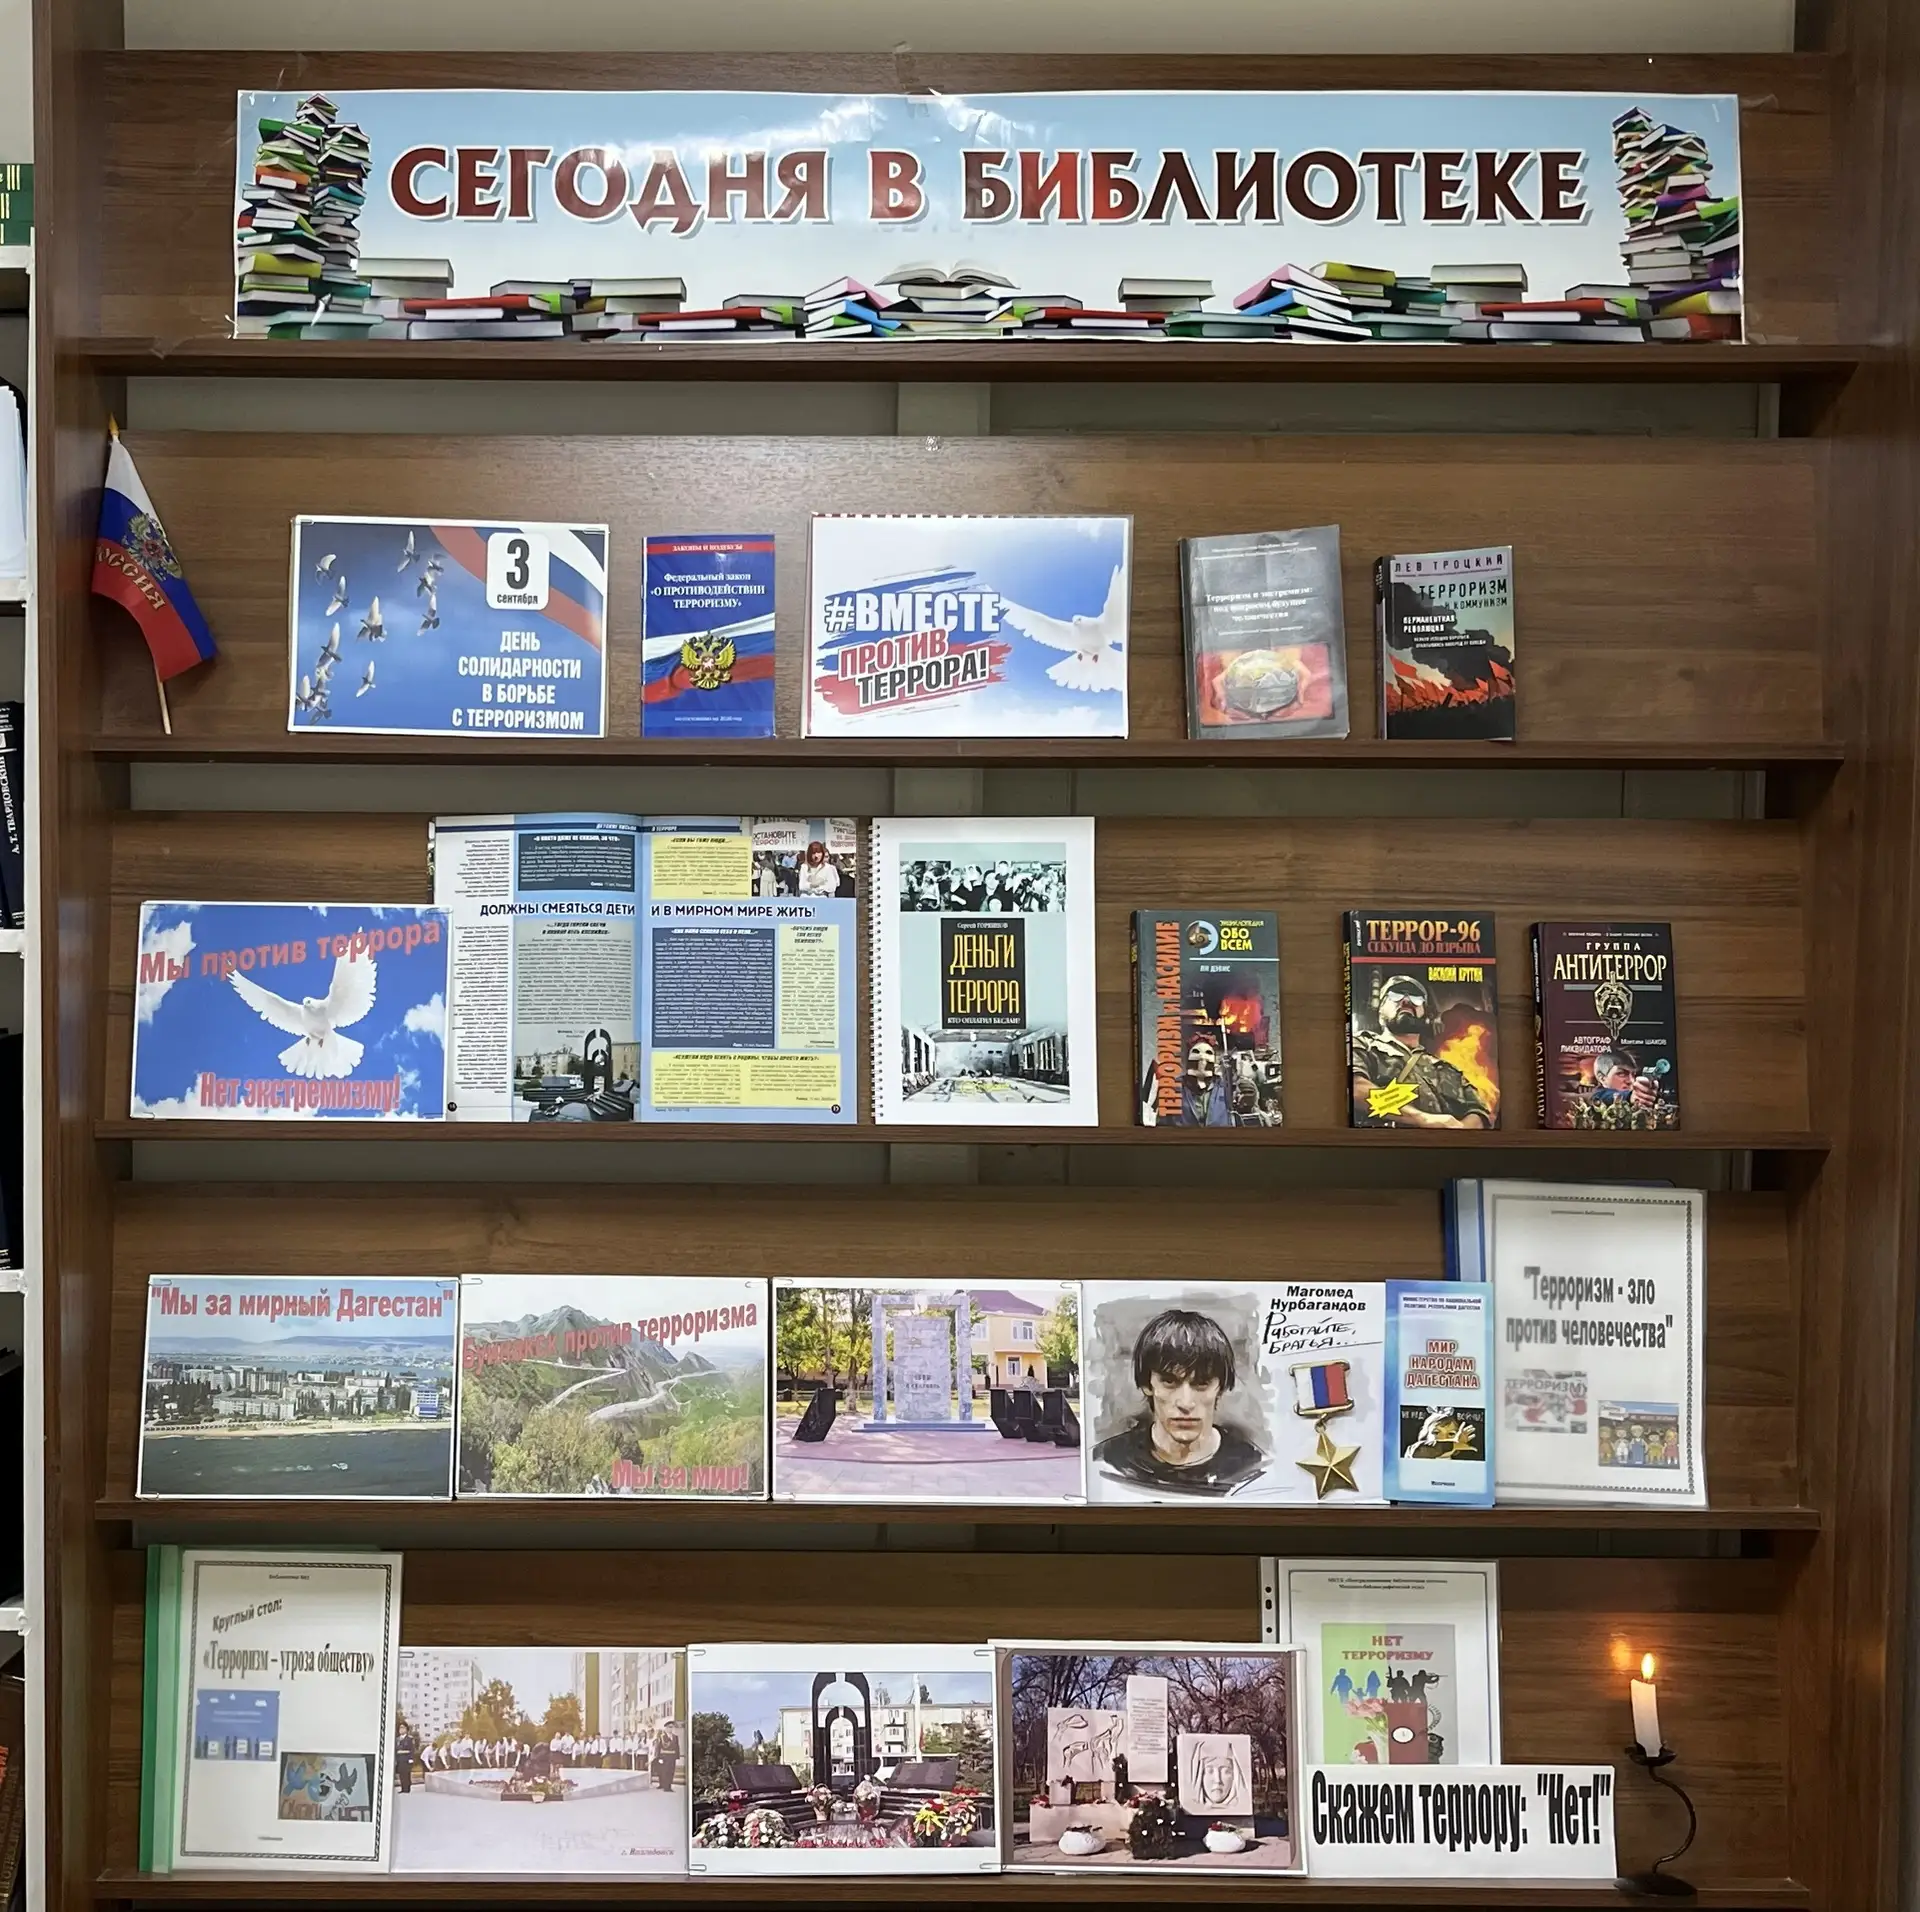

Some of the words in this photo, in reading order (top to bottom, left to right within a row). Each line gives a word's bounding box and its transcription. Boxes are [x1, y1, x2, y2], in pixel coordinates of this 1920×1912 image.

[389, 145, 830, 237] СЕГОДНЯ
[867, 147, 925, 222] В
[959, 148, 1589, 225] БИБЛИОТЕКЕ
[506, 538, 530, 590] 3
[1394, 562, 1422, 573] ЛЕВ
[1433, 554, 1504, 570] ТРОЦКИЙ
[664, 573, 724, 583] Федеральный
[726, 573, 751, 581] закон
[496, 593, 539, 605] сентября
[664, 584, 765, 596] ПРОТИВОДЕЙСТВИИ
[1206, 592, 1251, 603] Терроризм
[1419, 579, 1508, 601] ТЕРРОРИЗМ
[824, 592, 1000, 633] #ВМЕСТЕ
[1453, 597, 1508, 610] КОММУНИЗМ
[500, 631, 541, 653] ДЕНЬ
[839, 627, 948, 678] ПРОТИВ
[458, 656, 582, 679] СОЛИДАРНОСТИ
[857, 649, 988, 706] ТЕРРОРА!
[482, 683, 492, 703] В
[496, 683, 556, 705] БОРЬБЕ
[452, 708, 463, 727] С
[467, 708, 584, 730] ТЕРРОРИЗМОМ
[480, 904, 539, 917] ДОЛЖНЫ
[541, 903, 603, 915] СМЕЯТЬСЯ
[606, 904, 636, 916] ДЕТИ
[651, 905, 660, 917] И
[664, 905, 671, 917] В
[675, 905, 734, 917] МИРНОМ
[737, 905, 773, 917] МИРЕ
[776, 906, 816, 918] ЖИТЬ!
[1220, 927, 1250, 939] ОБО
[1366, 919, 1481, 942] ТЕРРОР-96
[140, 952, 190, 984] Мы
[202, 939, 307, 981] против
[317, 920, 441, 964] террора
[949, 934, 1016, 976] ДЕНЬГИ
[1220, 938, 1253, 951] ВСЕМ
[1367, 941, 1417, 953] СЕКУНДА
[1419, 941, 1435, 953] ДО
[1436, 942, 1481, 954] ВЗРЫВА
[1585, 942, 1641, 951] ГРУППА
[1155, 920, 1181, 999] НАСИЛИЕ
[1553, 953, 1668, 982] АНТИТЕРРОР
[947, 979, 1021, 1014] ТЕРРОРА
[1560, 1044, 1613, 1054] ЛИКВИДАТОРА
[1573, 1036, 1612, 1045] АВТОГРАФ
[1156, 1015, 1183, 1117] ТЕРРОРИЗМ
[200, 1072, 241, 1107] Нет
[244, 1074, 401, 1112] экстремизму!
[1286, 1285, 1354, 1300] Магомед
[1523, 1266, 1614, 1311] "Терроризм
[1627, 1278, 1656, 1305] зло
[151, 1286, 198, 1316] "Мы
[205, 1294, 232, 1317] за
[239, 1287, 331, 1323] мирный
[336, 1288, 454, 1323] Дагестан"
[1270, 1298, 1367, 1312] Нурбагандов
[564, 1322, 633, 1360] против
[638, 1302, 757, 1346] терроризма
[1506, 1317, 1557, 1351] против
[1561, 1314, 1674, 1349] человечества"
[1427, 1340, 1458, 1354] МИР
[1411, 1356, 1475, 1372] НАРОДАМ
[1406, 1372, 1479, 1388] ДАГЕСТАНА
[611, 1459, 656, 1490] Мы
[659, 1466, 687, 1490] за
[691, 1462, 749, 1494] мир!
[212, 1604, 255, 1632] Круглый
[256, 1598, 283, 1618] стол:
[1372, 1635, 1404, 1646] НЕТ
[202, 1641, 269, 1679] «Терроризм
[280, 1649, 316, 1680] угроза
[317, 1643, 375, 1681] обществу»
[1342, 1651, 1434, 1661] ТЕРРОРИЗМУ
[1311, 1769, 1416, 1846] Скажем
[1418, 1783, 1529, 1852] террору:
[1537, 1772, 1612, 1845] "Нет!"
